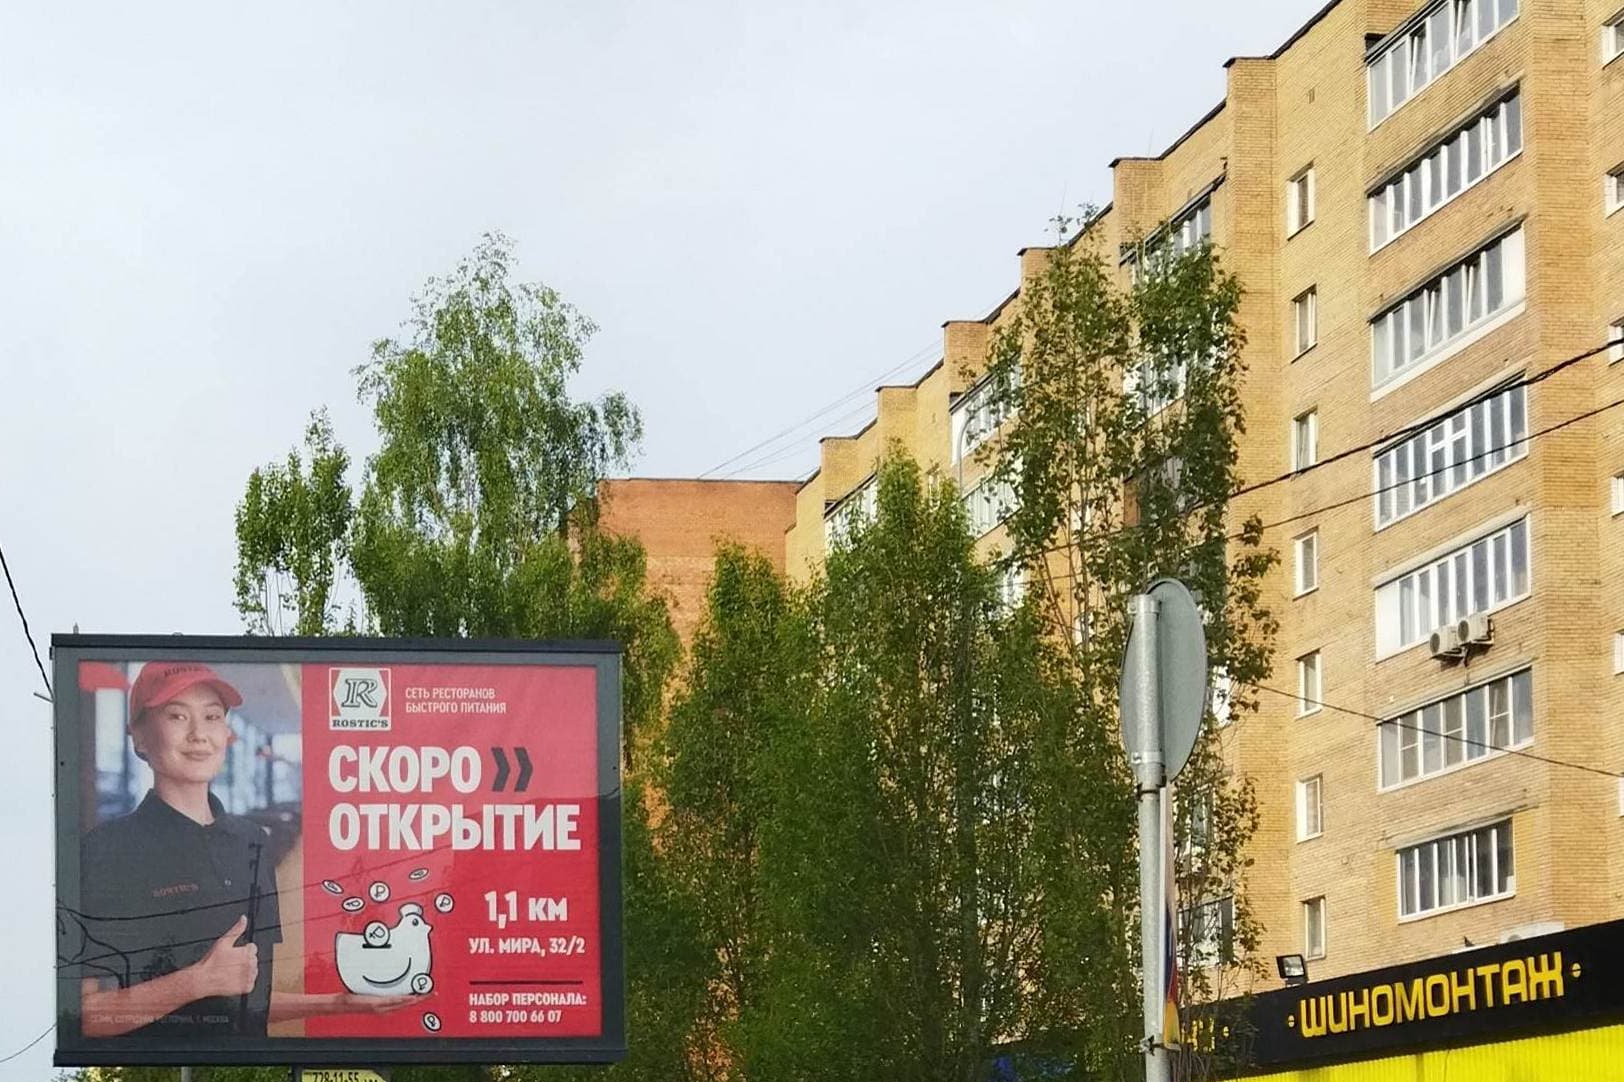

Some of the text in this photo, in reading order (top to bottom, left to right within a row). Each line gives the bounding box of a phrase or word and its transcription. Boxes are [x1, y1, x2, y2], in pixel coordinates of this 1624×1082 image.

[405, 687, 496, 700] СЕТЬ РЕСТОРАНОВ
[405, 702, 507, 713] БЫСТРОГО ПИТАНИЯ
[332, 718, 389, 729] ROSTIC'S
[328, 745, 482, 793] СКОРО
[329, 803, 582, 850] ОТКРЫТИЕ
[484, 890, 518, 929] 1,1
[468, 935, 586, 957] УЛ. МИРА, 32/2
[468, 992, 587, 1006] НАБОР ПЕРСОНАЛА:
[1299, 951, 1565, 1038] ШИНОМОНТАЖ
[469, 1010, 562, 1024] 8 800 700 66 07
